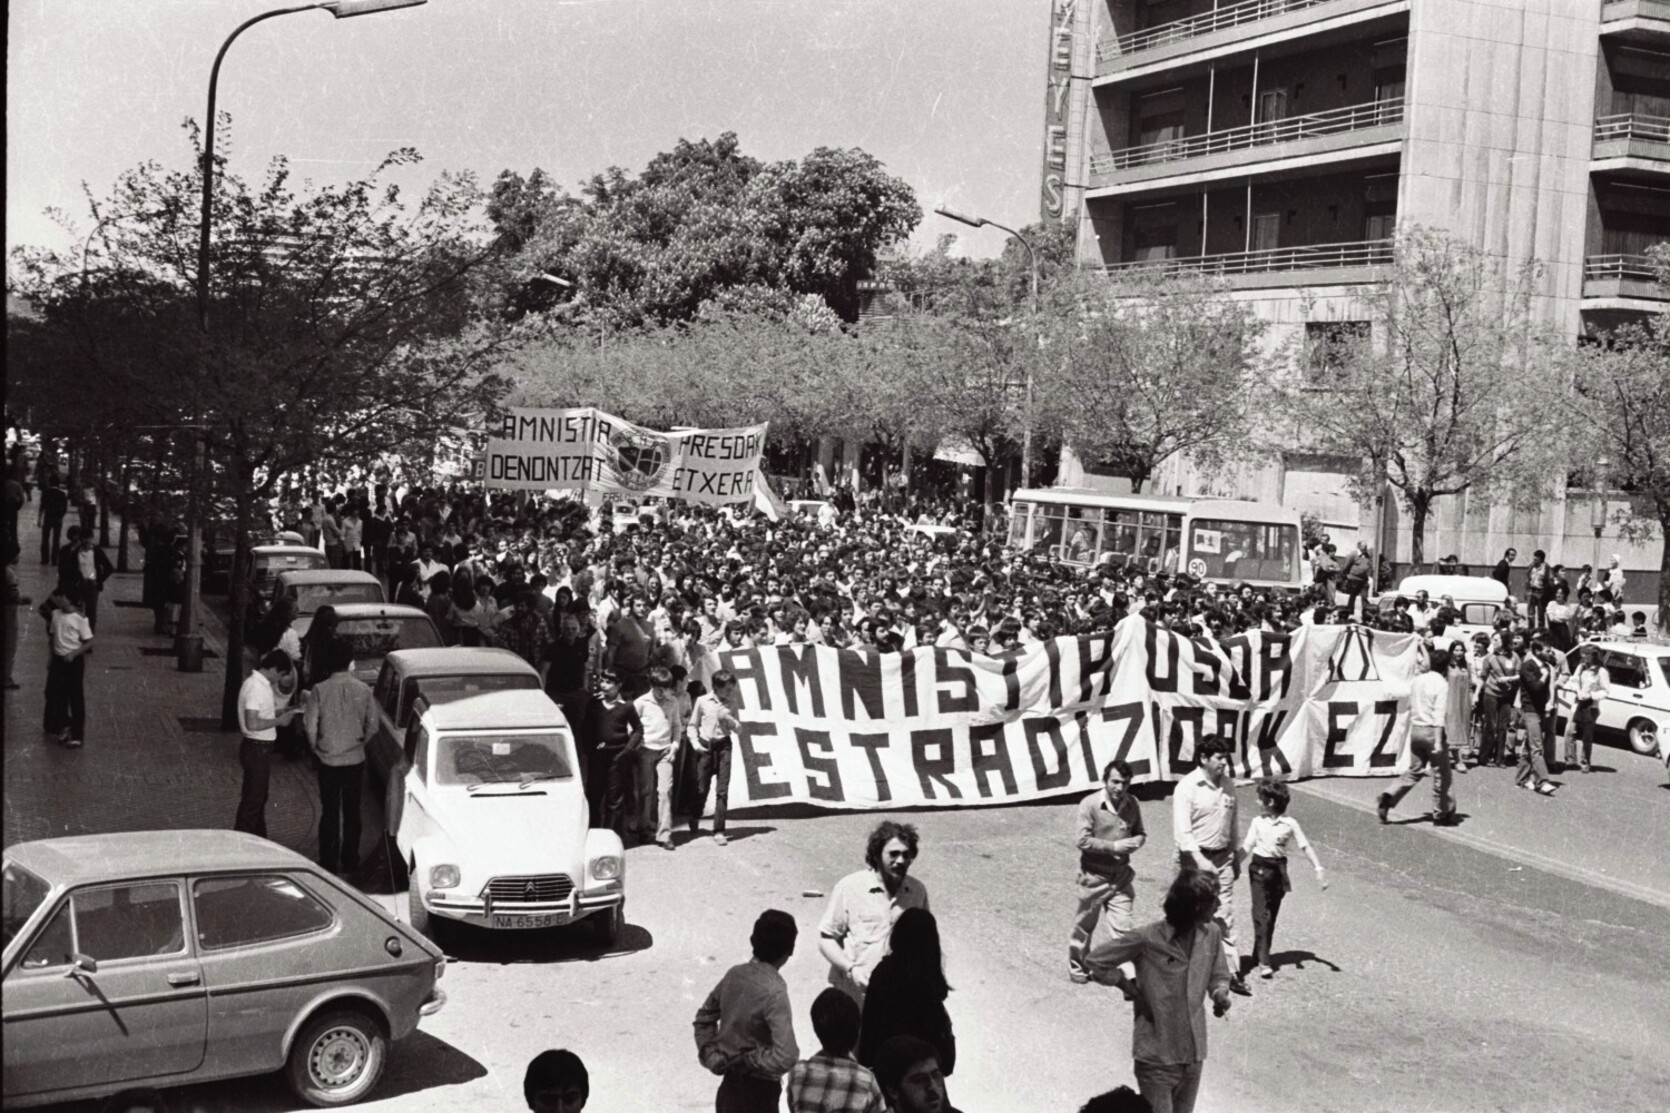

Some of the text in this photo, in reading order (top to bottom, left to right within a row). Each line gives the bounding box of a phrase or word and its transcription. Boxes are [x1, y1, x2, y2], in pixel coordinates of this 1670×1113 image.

[503, 415, 612, 445] AMNISTIA
[491, 454, 606, 482] DENONTZAT
[672, 467, 754, 496] ETXERA
[718, 630, 1115, 720] AMNISTIA
[1322, 700, 1399, 769] EZ
[496, 916, 513, 928] NA
